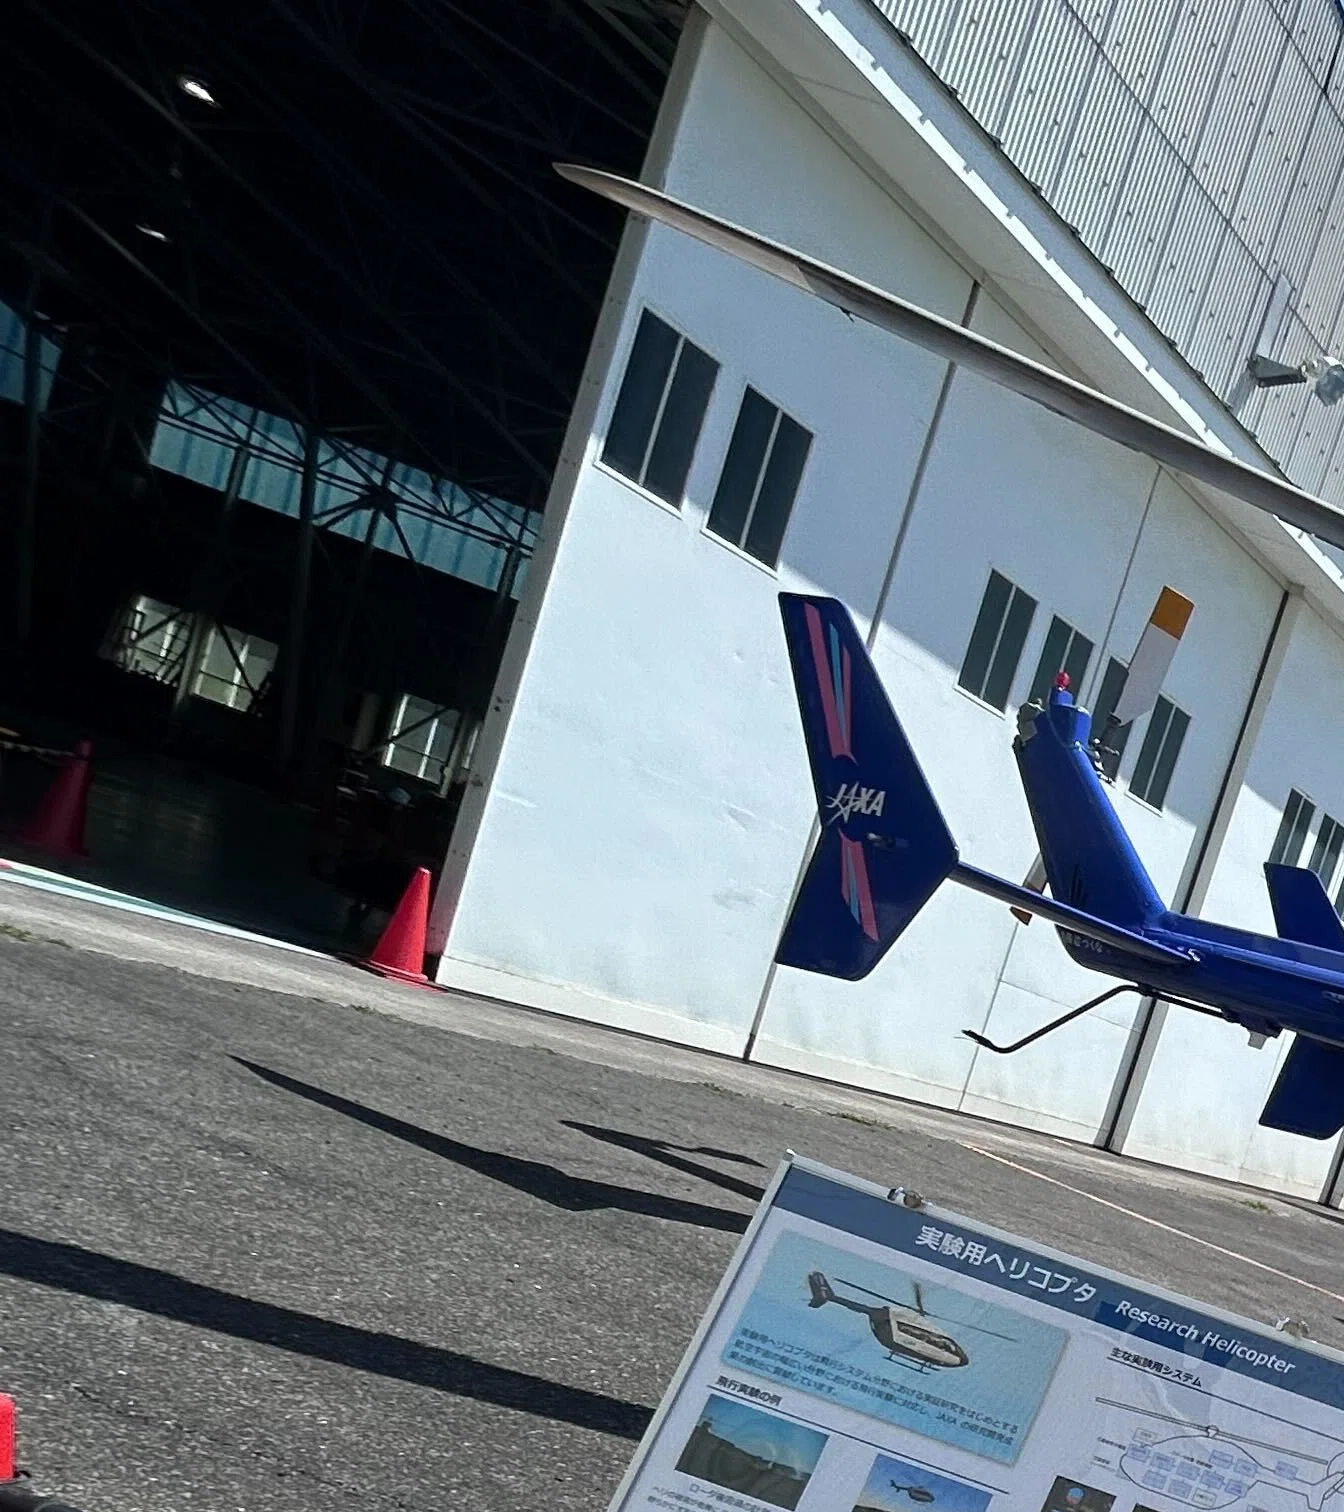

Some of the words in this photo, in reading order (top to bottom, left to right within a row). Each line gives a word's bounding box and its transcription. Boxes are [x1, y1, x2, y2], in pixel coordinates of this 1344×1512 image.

[825, 781, 886, 826] JAXA
[914, 1224, 1098, 1306] 実験用ヘリコプタ
[1114, 1298, 1201, 1341] Research
[1198, 1329, 1297, 1375] Helicopter
[1109, 1346, 1204, 1388] 主な実験用システム
